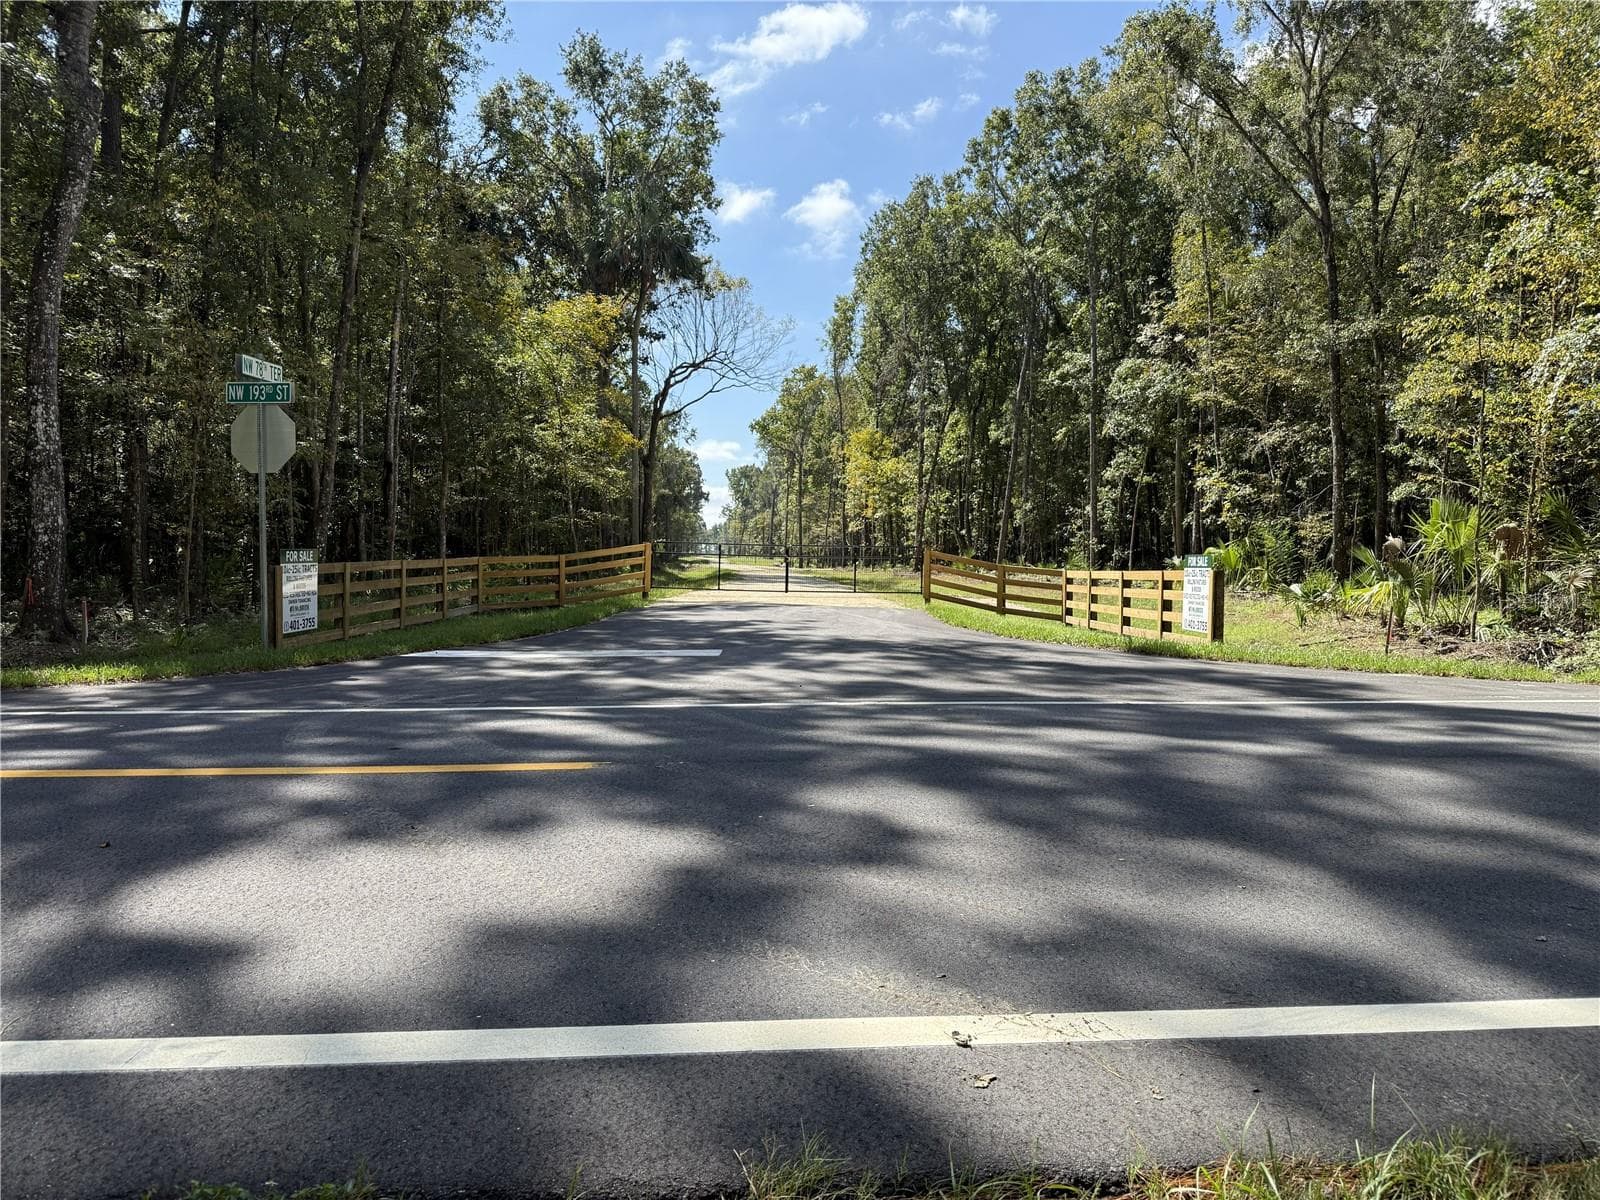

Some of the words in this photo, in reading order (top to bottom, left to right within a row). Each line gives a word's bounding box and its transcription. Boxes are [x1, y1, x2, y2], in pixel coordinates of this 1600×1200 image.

[243, 356, 253, 375] NW
[270, 365, 281, 382] TER
[228, 384, 244, 400] NW
[276, 384, 289, 400] ST
[285, 550, 298, 562] FOR
[299, 550, 313, 562] SALE
[289, 617, 315, 631] 401-3755
